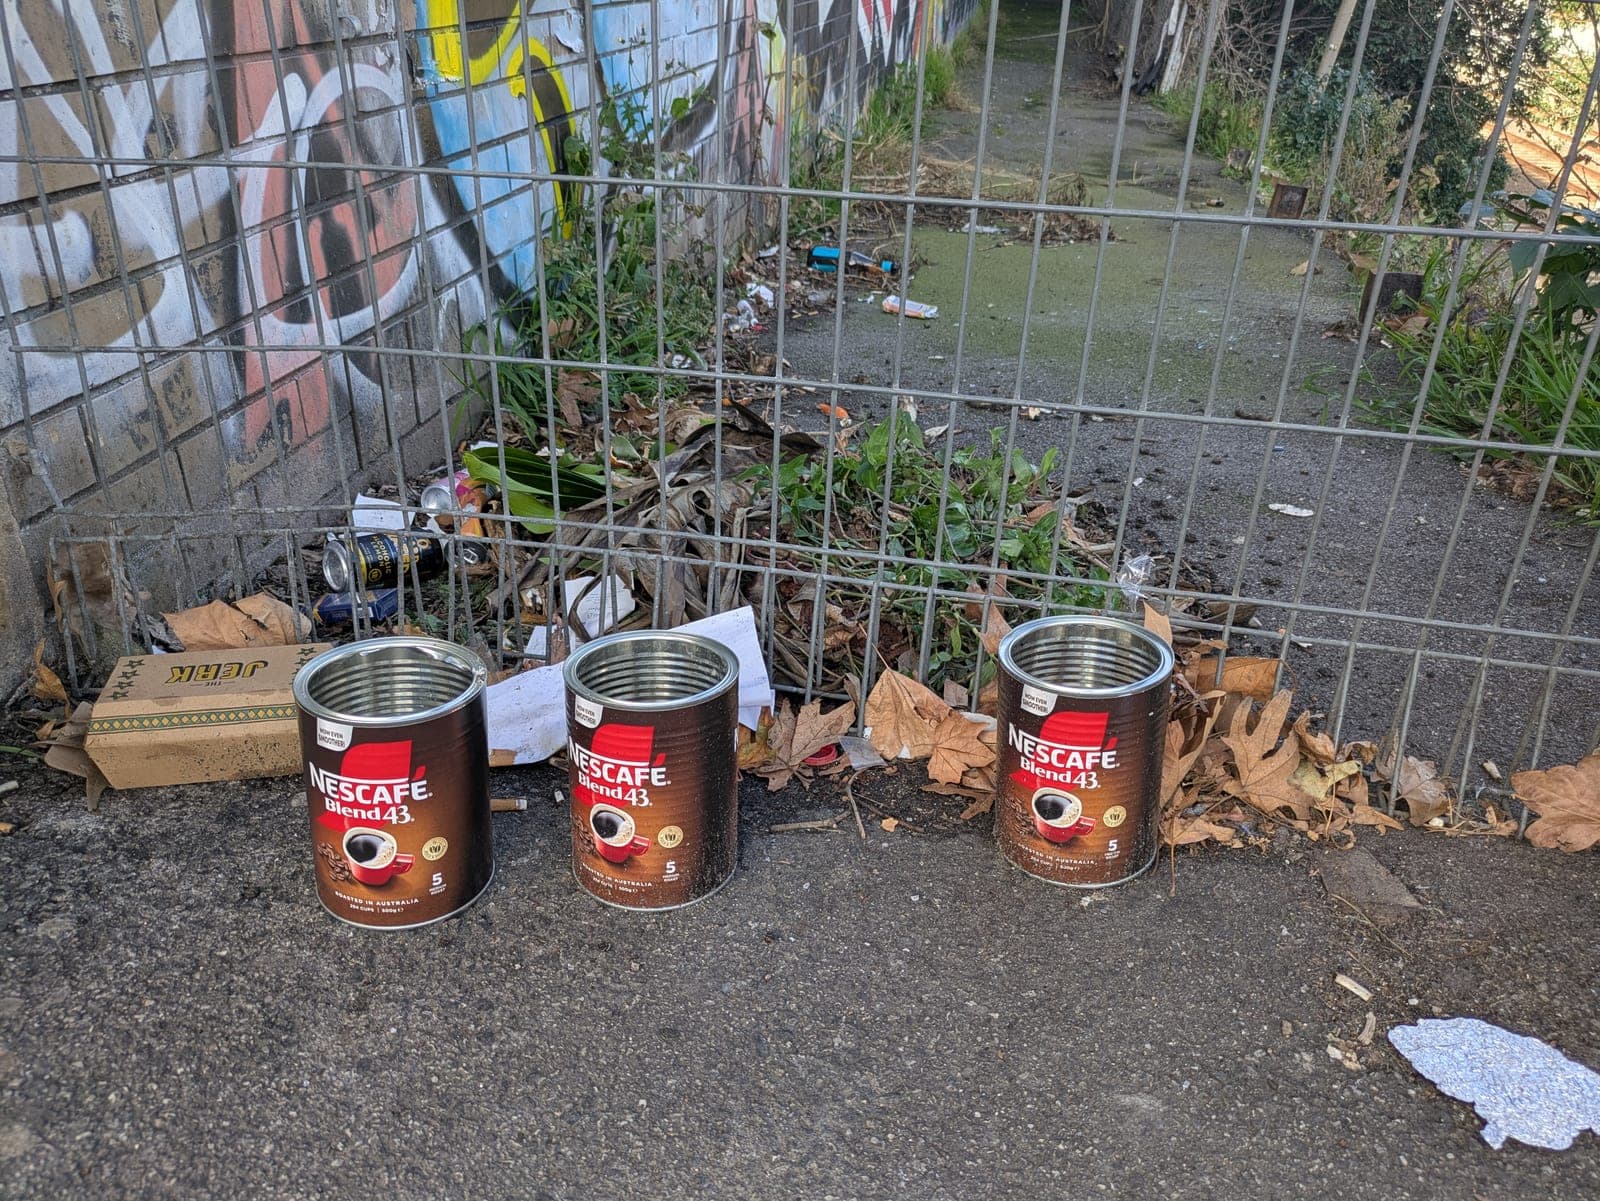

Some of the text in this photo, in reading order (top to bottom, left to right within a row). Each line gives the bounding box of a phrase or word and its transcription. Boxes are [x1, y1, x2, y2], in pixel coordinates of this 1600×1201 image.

[370, 541, 384, 567] LEMON
[165, 660, 269, 684] JERK
[1020, 756, 1072, 784] Blend
[578, 771, 623, 800] Blend
[324, 797, 381, 821] Blend
[1108, 839, 1118, 851] 5
[665, 861, 676, 874] 5
[432, 872, 443, 886] 5
[614, 878, 653, 887] AUSTRALIA
[334, 890, 363, 904] ROASTED
[375, 898, 420, 906] AUSTRALIA
